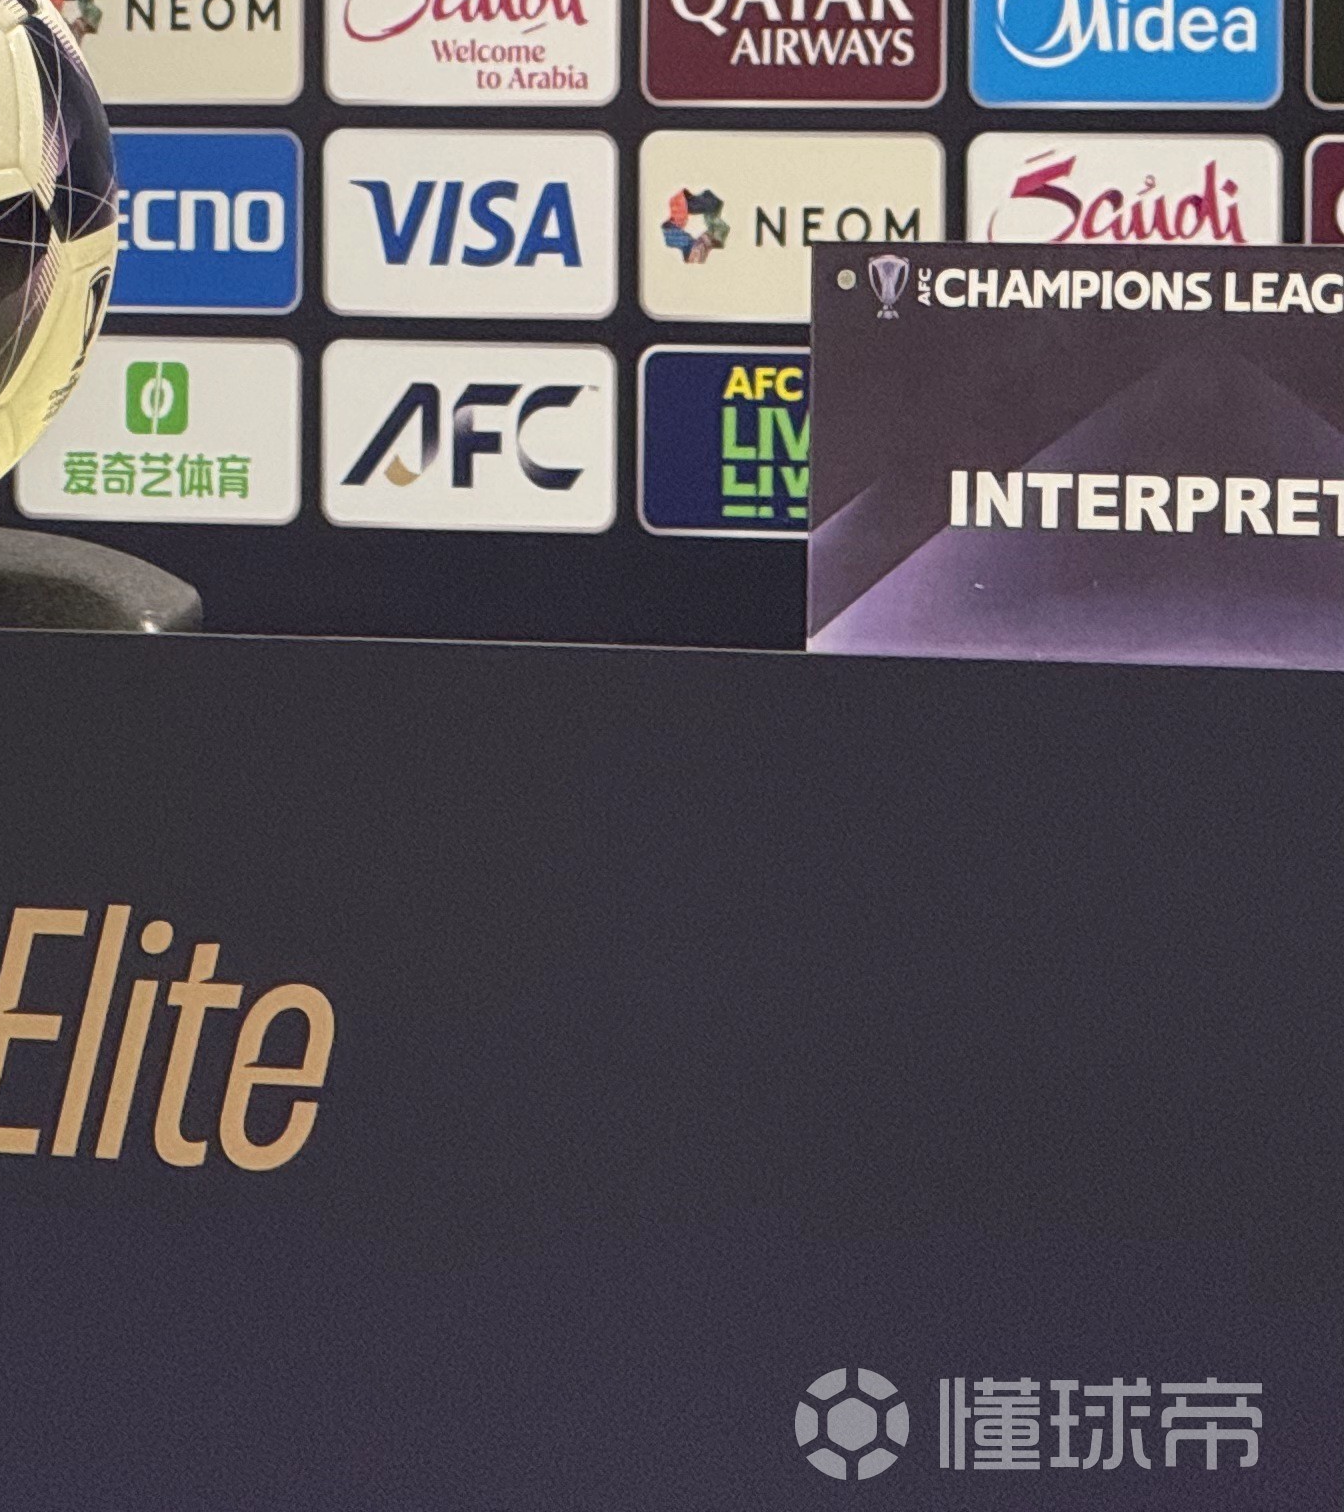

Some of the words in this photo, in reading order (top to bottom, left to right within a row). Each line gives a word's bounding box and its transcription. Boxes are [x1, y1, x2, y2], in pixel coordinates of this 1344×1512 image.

[431, 39, 546, 64] Welcome
[730, 27, 915, 67] AIRWAYS
[476, 67, 502, 91] to
[508, 65, 589, 90] Arabia
[987, 149, 1250, 243] Saudi
[117, 190, 285, 252] CNO
[349, 180, 582, 268] VISA
[754, 206, 922, 248] NEOM
[917, 268, 932, 307] AFC
[934, 268, 1213, 312] CHAMPIONS
[1224, 271, 1344, 314] LEAG
[723, 366, 804, 402] AFC
[340, 382, 584, 490] AFC
[722, 406, 810, 462] LIV
[63, 451, 252, 500] 爱奇艺体育
